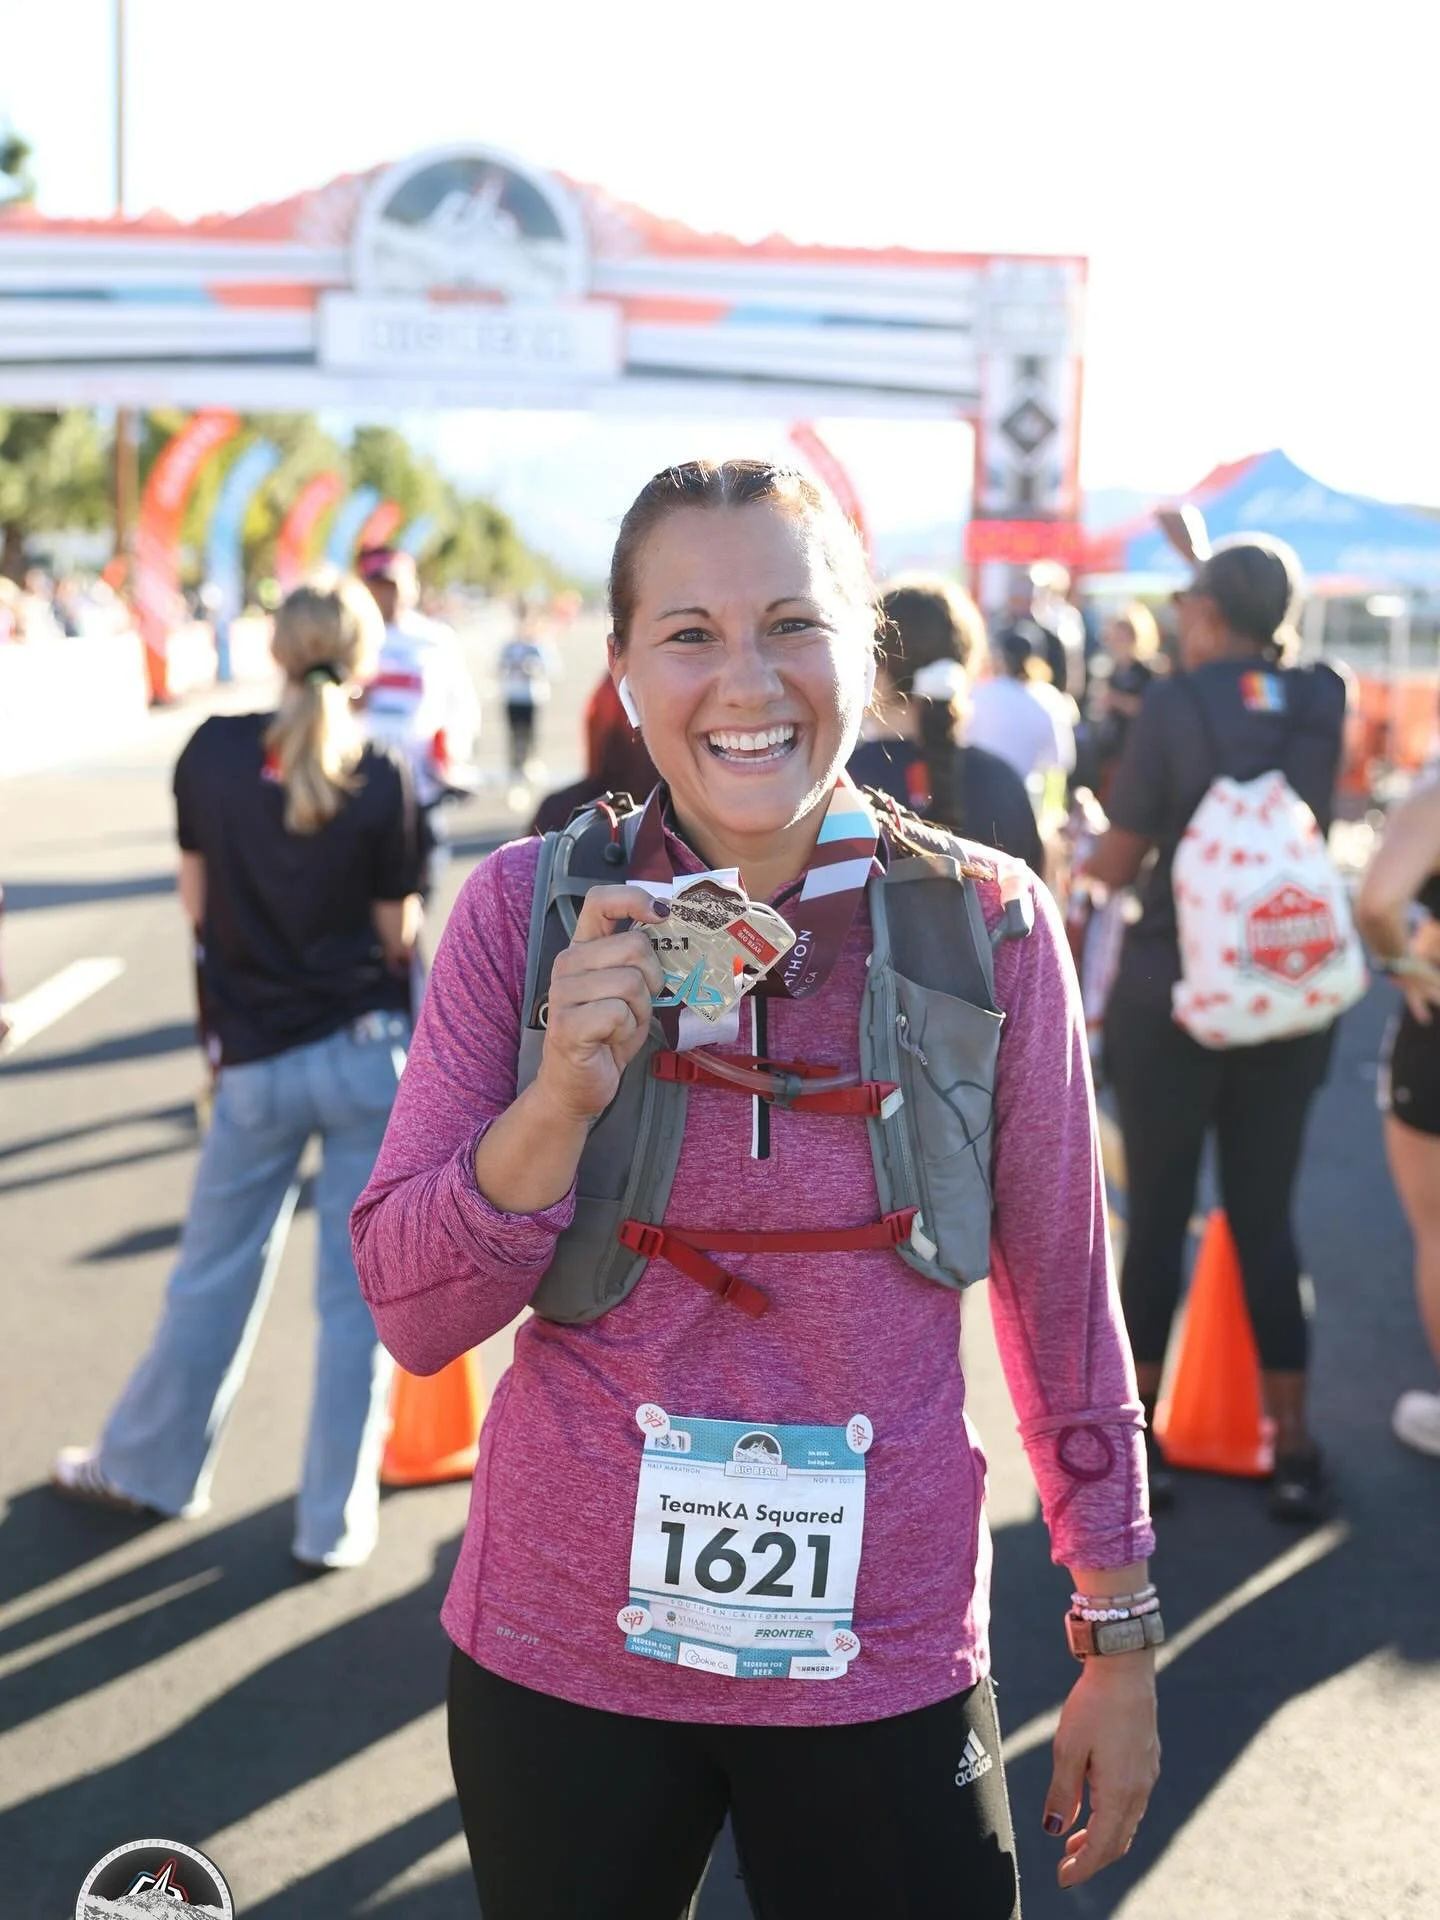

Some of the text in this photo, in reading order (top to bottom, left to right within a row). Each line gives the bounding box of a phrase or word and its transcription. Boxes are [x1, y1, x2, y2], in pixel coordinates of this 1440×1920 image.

[651, 937, 689, 951] 13.1
[665, 1465, 700, 1474] MARATHON
[735, 1466, 778, 1476] BIG BEAR
[660, 1495, 844, 1526] TeamKA Squared
[661, 1521, 831, 1598] 1621
[671, 1599, 799, 1620] SOUTHERN CALIFORNIA
[754, 1629, 814, 1639] FRONTIER
[632, 1637, 672, 1652] REDEEM FOR
[631, 1645, 672, 1659] SWEET TREAT
[955, 1754, 993, 1787] adidas
